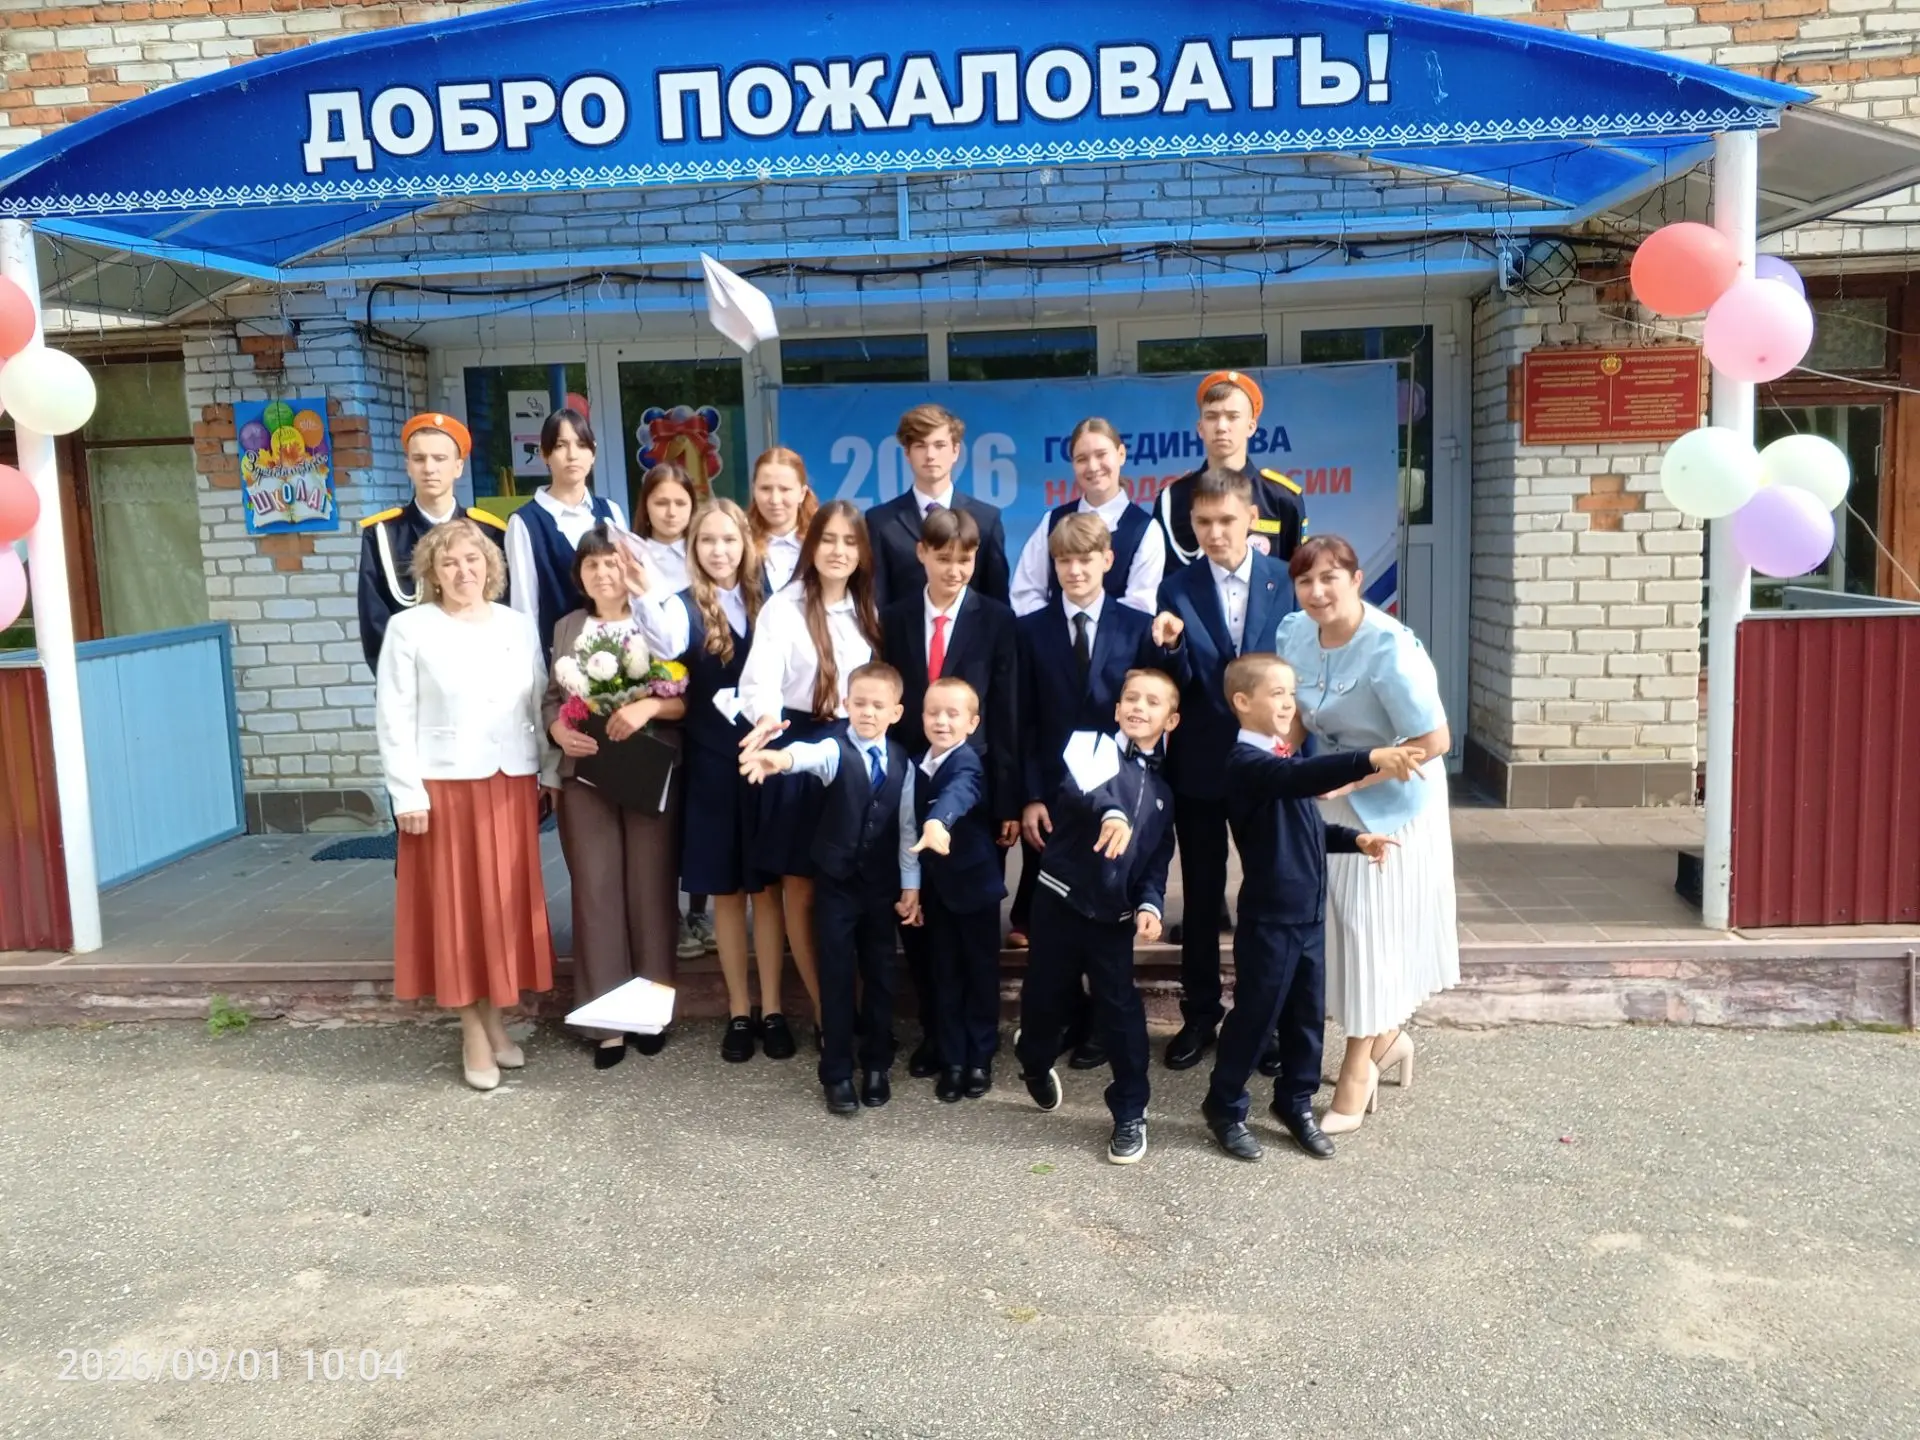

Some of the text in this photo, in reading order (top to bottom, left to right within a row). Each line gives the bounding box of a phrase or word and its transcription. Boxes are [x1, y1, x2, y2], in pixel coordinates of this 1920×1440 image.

[303, 32, 1392, 173] ДОБРО ПОЖАЛОВАТЬ!
[830, 432, 1018, 512] 206
[1118, 425, 1292, 466] ЕДИНВА
[250, 479, 327, 514] ШКОЛА!
